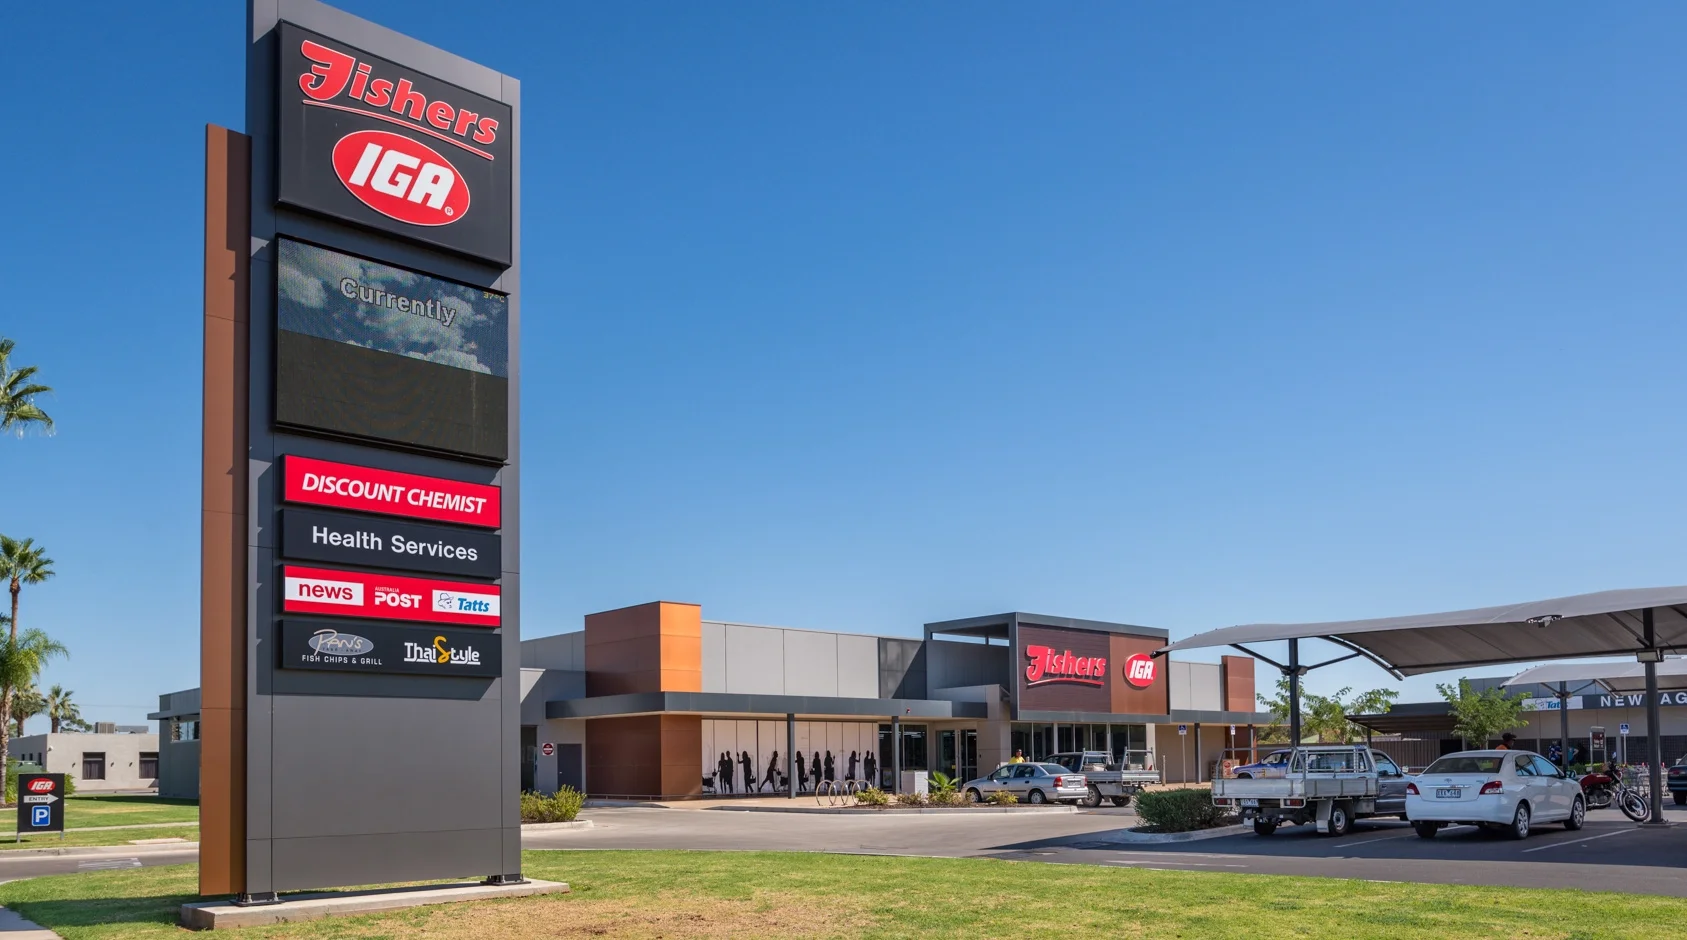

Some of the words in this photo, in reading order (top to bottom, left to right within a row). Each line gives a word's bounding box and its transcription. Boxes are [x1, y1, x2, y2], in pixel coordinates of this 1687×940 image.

[298, 40, 499, 146] Fishers
[348, 142, 455, 211] IGA
[339, 277, 457, 328] Currently
[301, 472, 406, 503] DISCOUNT
[406, 487, 487, 514] CHEMIST
[312, 525, 383, 551] Health
[391, 535, 478, 562] Services
[298, 583, 353, 600] news
[374, 591, 423, 608] POST
[457, 597, 490, 612] Tatts
[324, 656, 348, 664] CHIPS
[360, 657, 383, 665] GRILL
[1025, 644, 1107, 682] Fishers
[1129, 659, 1154, 680] IGA
[30, 781, 53, 791] IGA
[35, 808, 48, 823] P
